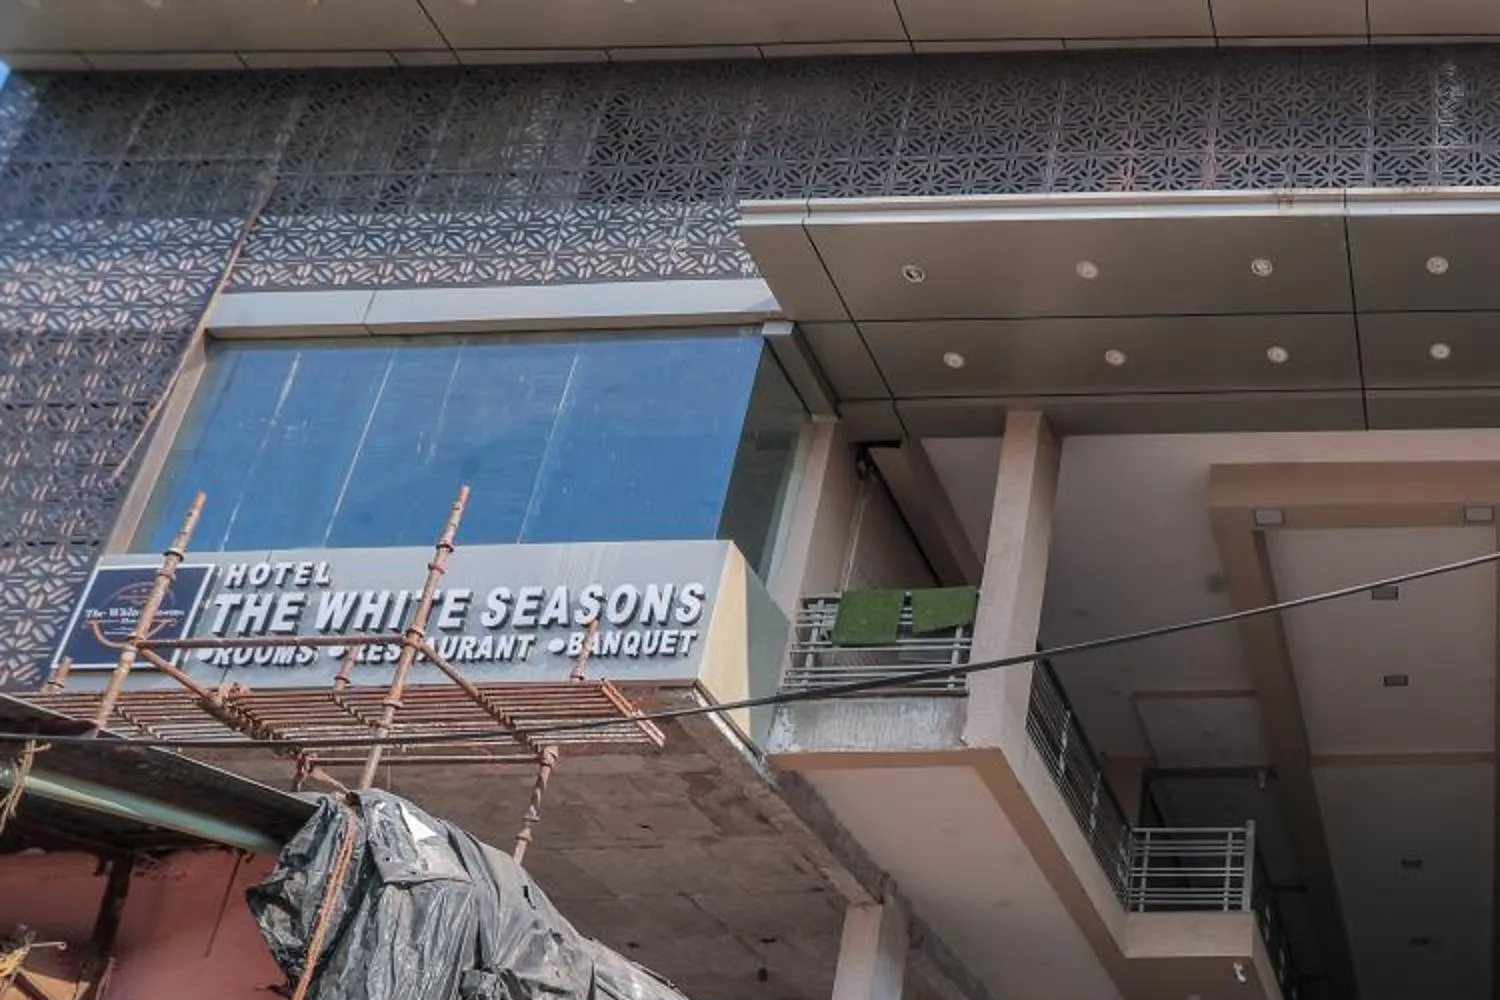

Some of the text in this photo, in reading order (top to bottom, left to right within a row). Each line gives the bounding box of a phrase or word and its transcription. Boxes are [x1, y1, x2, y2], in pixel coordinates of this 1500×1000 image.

[224, 561, 332, 588] HOTEL
[210, 592, 306, 633] THE
[481, 582, 704, 628] SEASONS
[211, 629, 698, 665] ROOMS ESAURANT BANQUET
